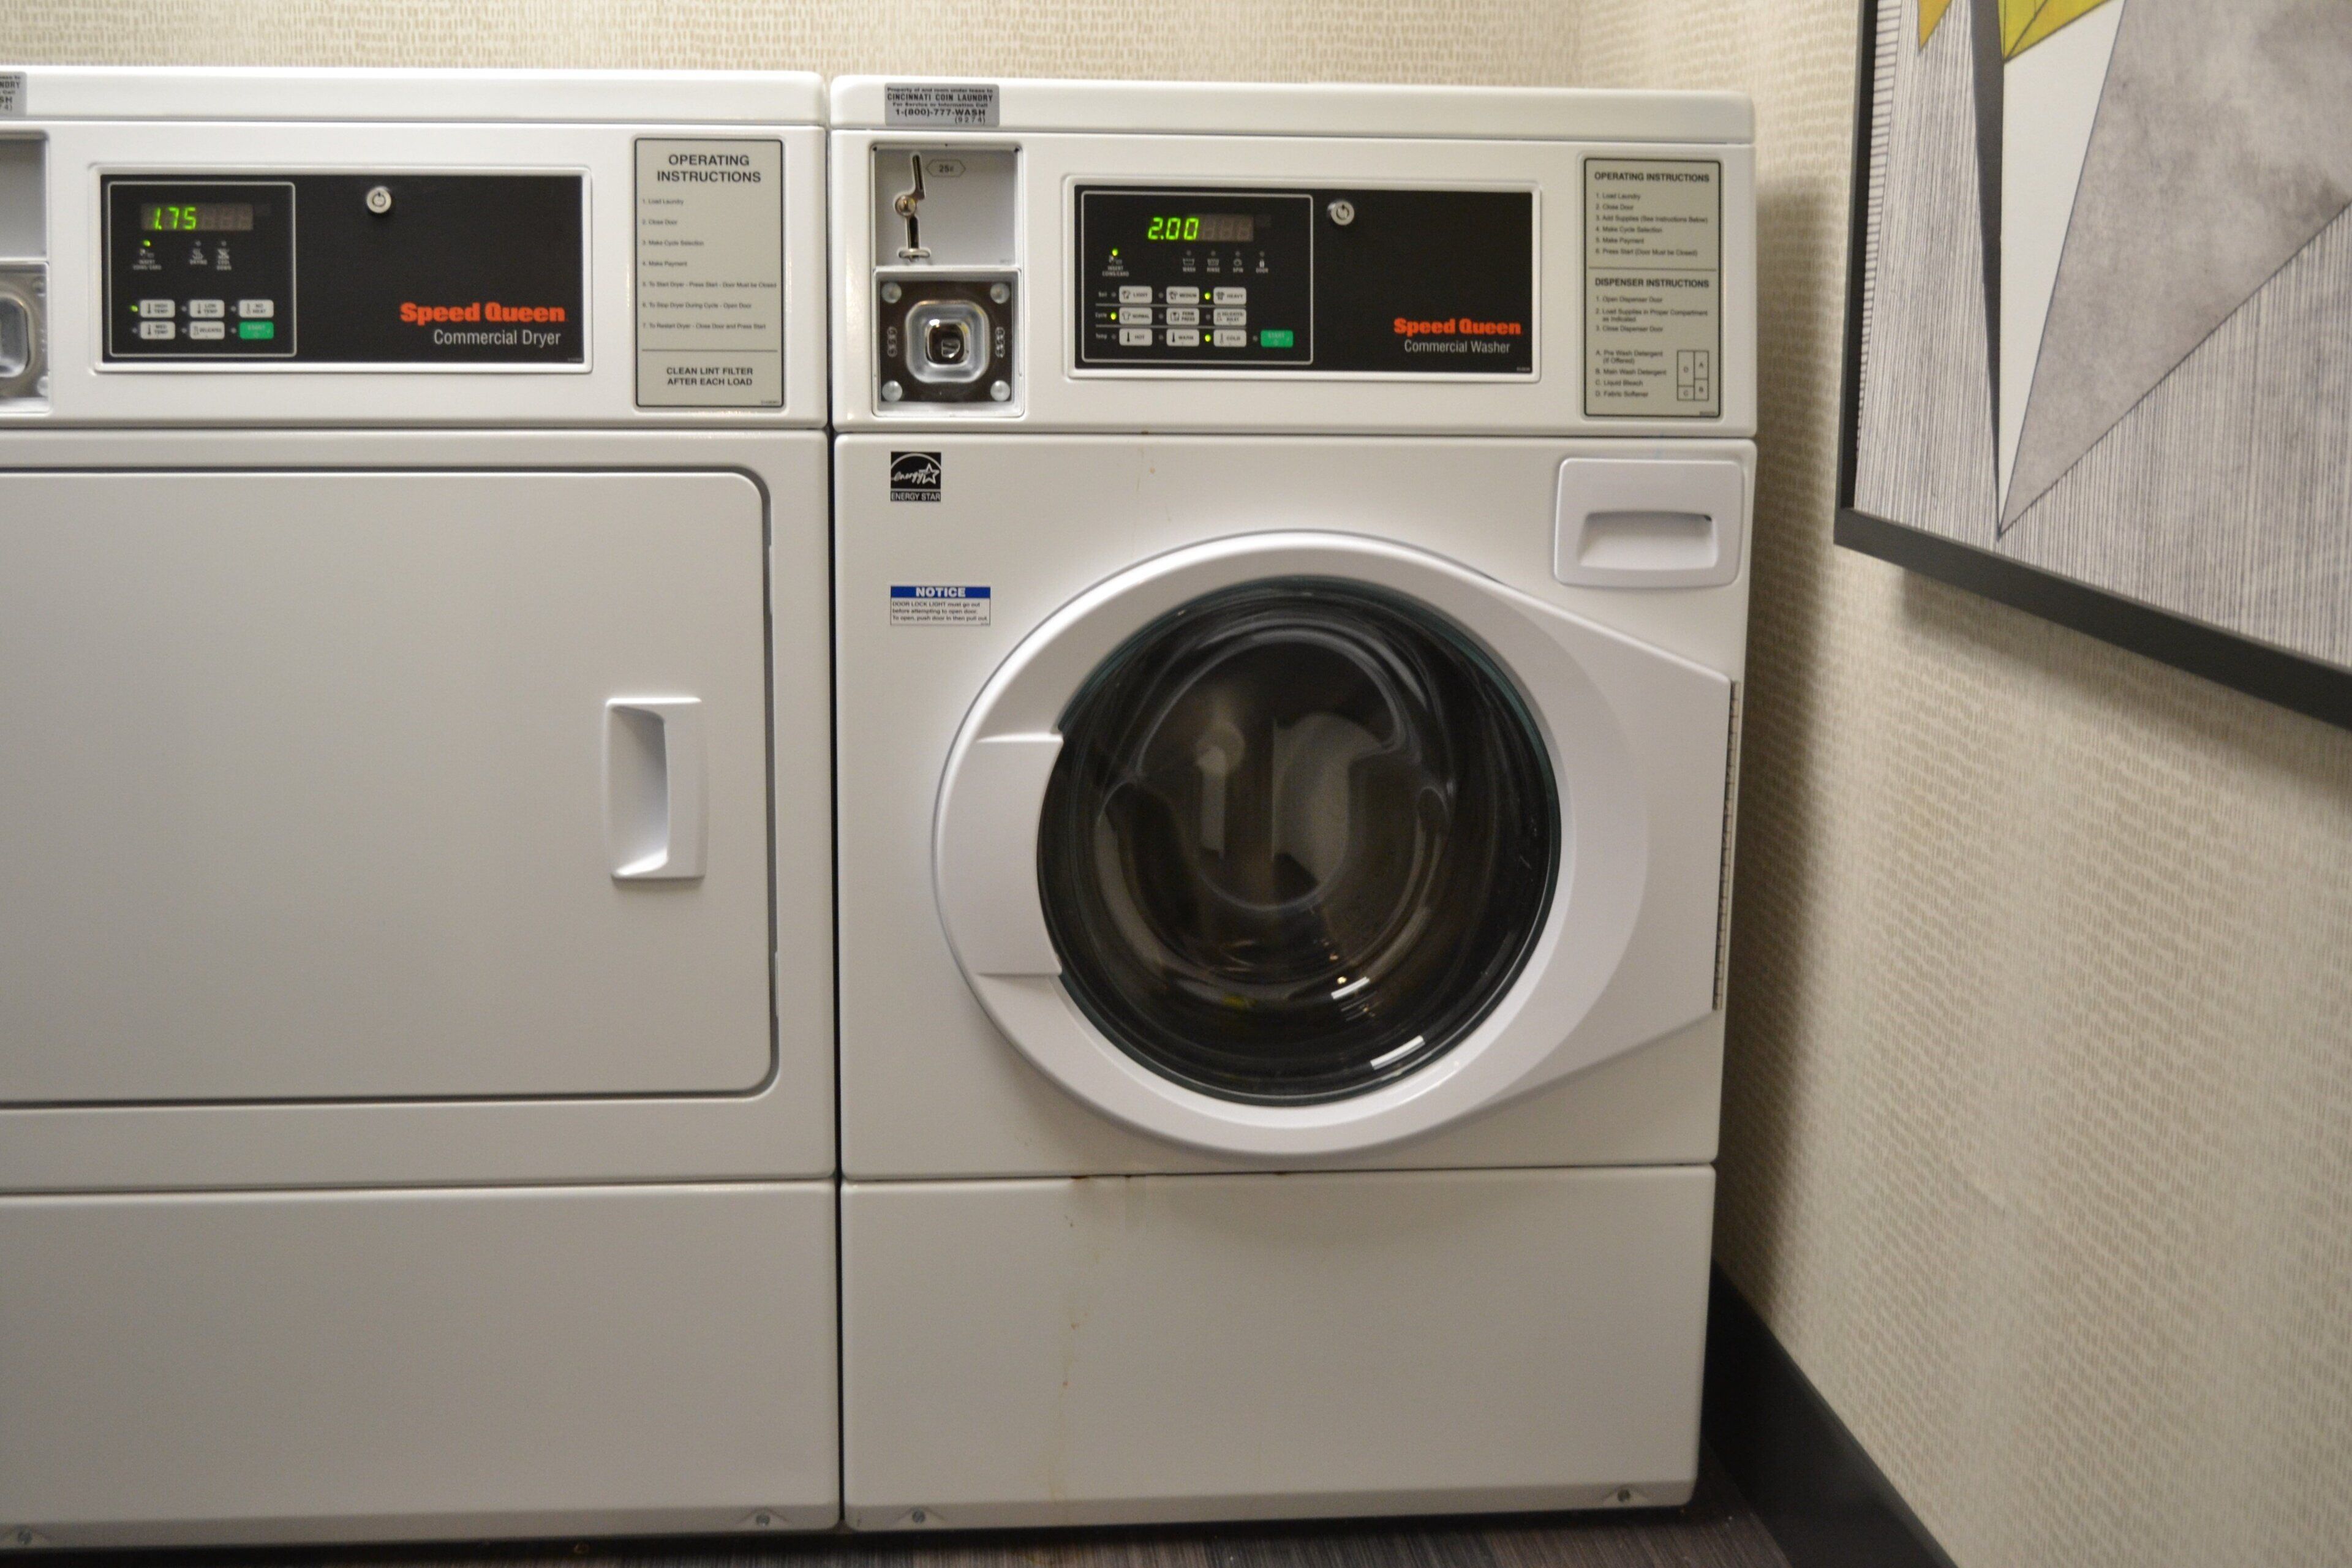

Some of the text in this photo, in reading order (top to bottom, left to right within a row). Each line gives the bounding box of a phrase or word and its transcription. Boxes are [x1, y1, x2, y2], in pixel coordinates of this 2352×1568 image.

[895, 108, 986, 117] 1-(800)-777-WASH
[668, 154, 750, 166] OPERATING
[657, 171, 761, 183] INSTRUCTIONS
[1594, 172, 1710, 182] OPERATING INSTRUCTIONS
[152, 207, 197, 230] 1.75
[1147, 217, 1199, 240] 2.00
[1595, 278, 1709, 287] DISPENSER INSTRUCTIONS
[400, 301, 565, 326] Speed Queen
[1393, 318, 1521, 336] Speed Queen
[434, 329, 561, 348] Commercial Dryer
[1404, 339, 1510, 353] Commercial Washer
[891, 492, 941, 501] ENERGY STAR
[916, 587, 966, 597] NOTICE
